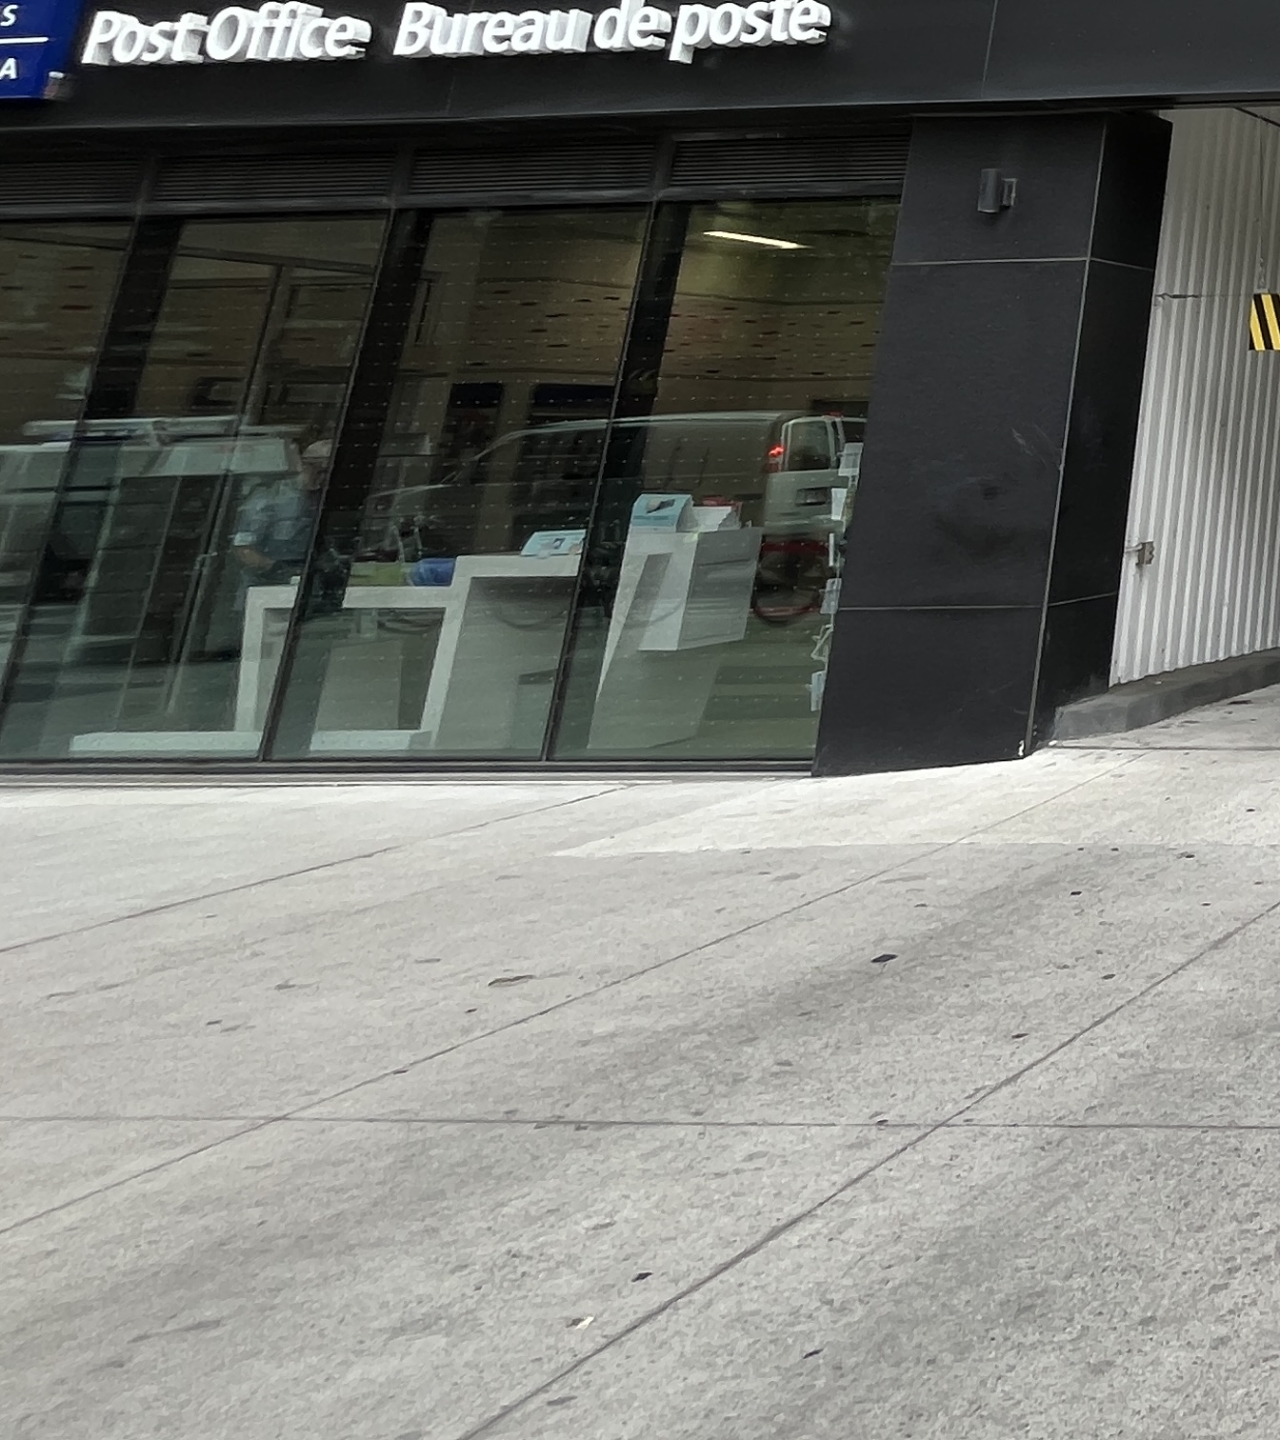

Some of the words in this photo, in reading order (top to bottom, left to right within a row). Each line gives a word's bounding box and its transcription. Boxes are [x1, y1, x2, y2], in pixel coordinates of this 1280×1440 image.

[81, 9, 207, 66] Post
[204, 0, 372, 63] Office
[393, 1, 593, 58] Bureau
